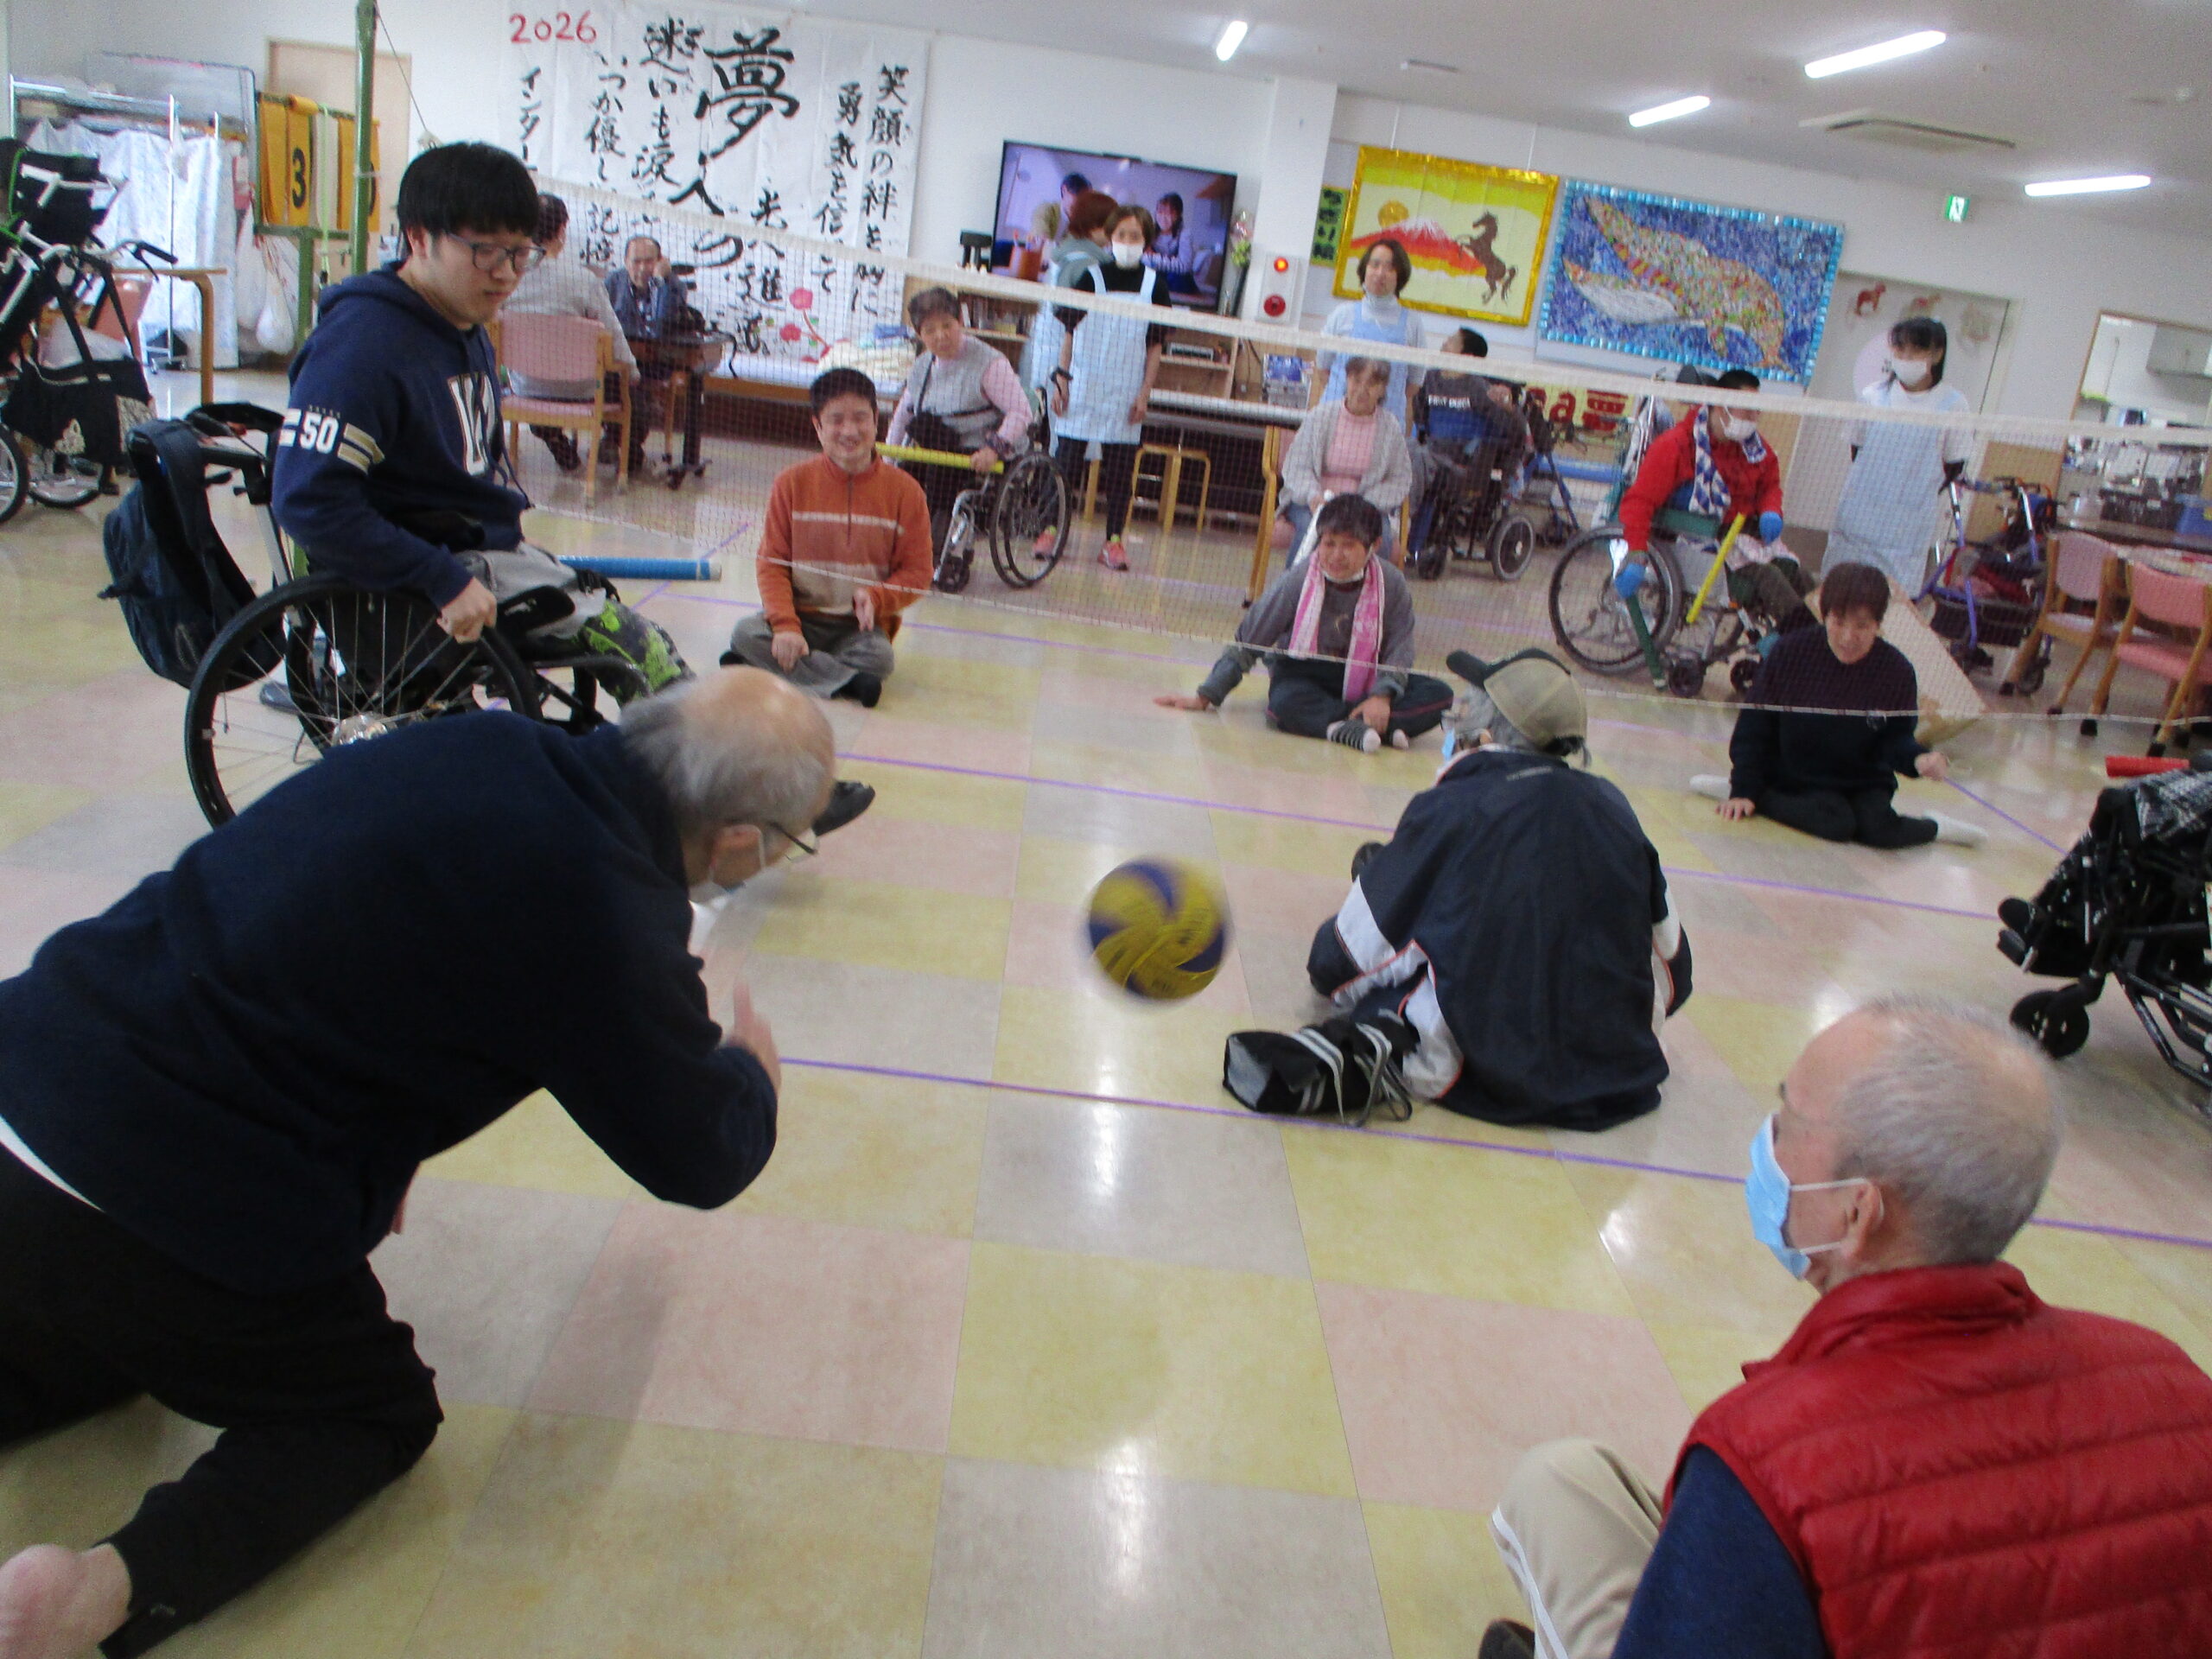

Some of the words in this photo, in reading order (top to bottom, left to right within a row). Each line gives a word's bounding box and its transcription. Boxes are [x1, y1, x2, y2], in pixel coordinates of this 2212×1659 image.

[509, 10, 598, 43] 2026
[519, 65, 542, 171] インター
[292, 147, 308, 209] 3
[299, 410, 340, 455] 50
